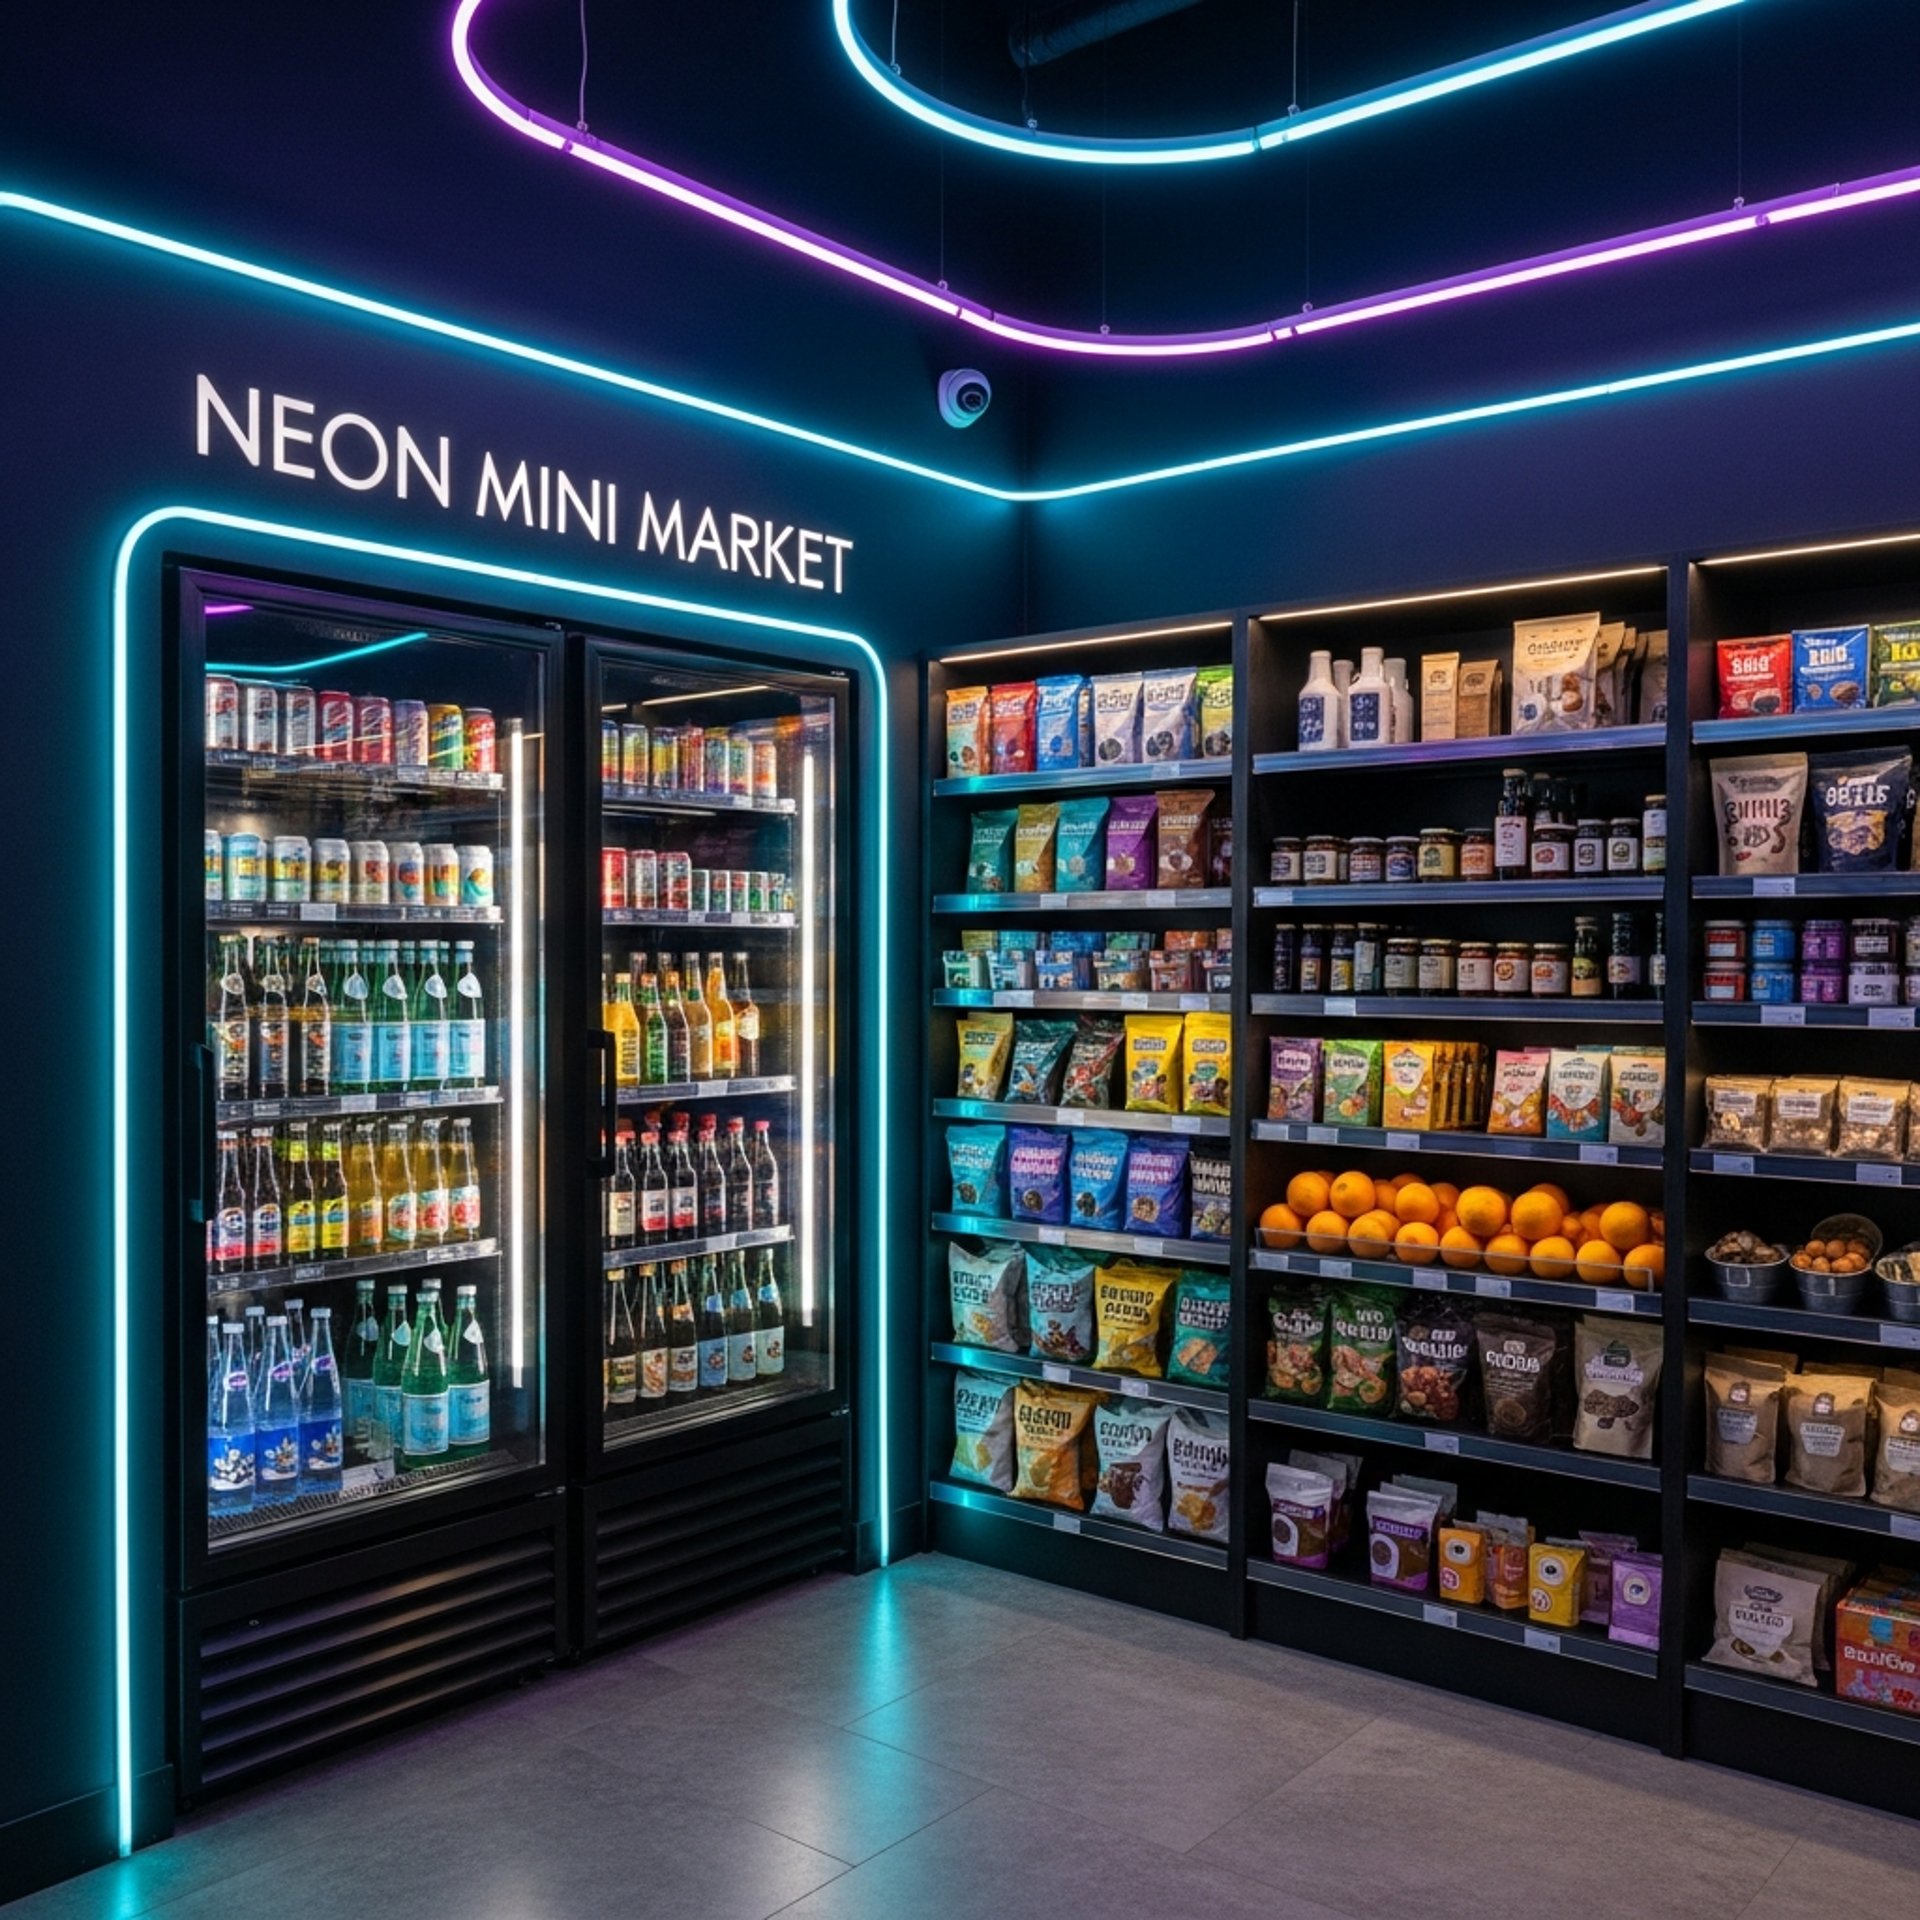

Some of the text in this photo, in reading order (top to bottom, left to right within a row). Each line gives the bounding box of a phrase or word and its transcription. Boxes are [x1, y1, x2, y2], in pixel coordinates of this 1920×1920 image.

[196, 373, 853, 593] NEON MINI MARKET
